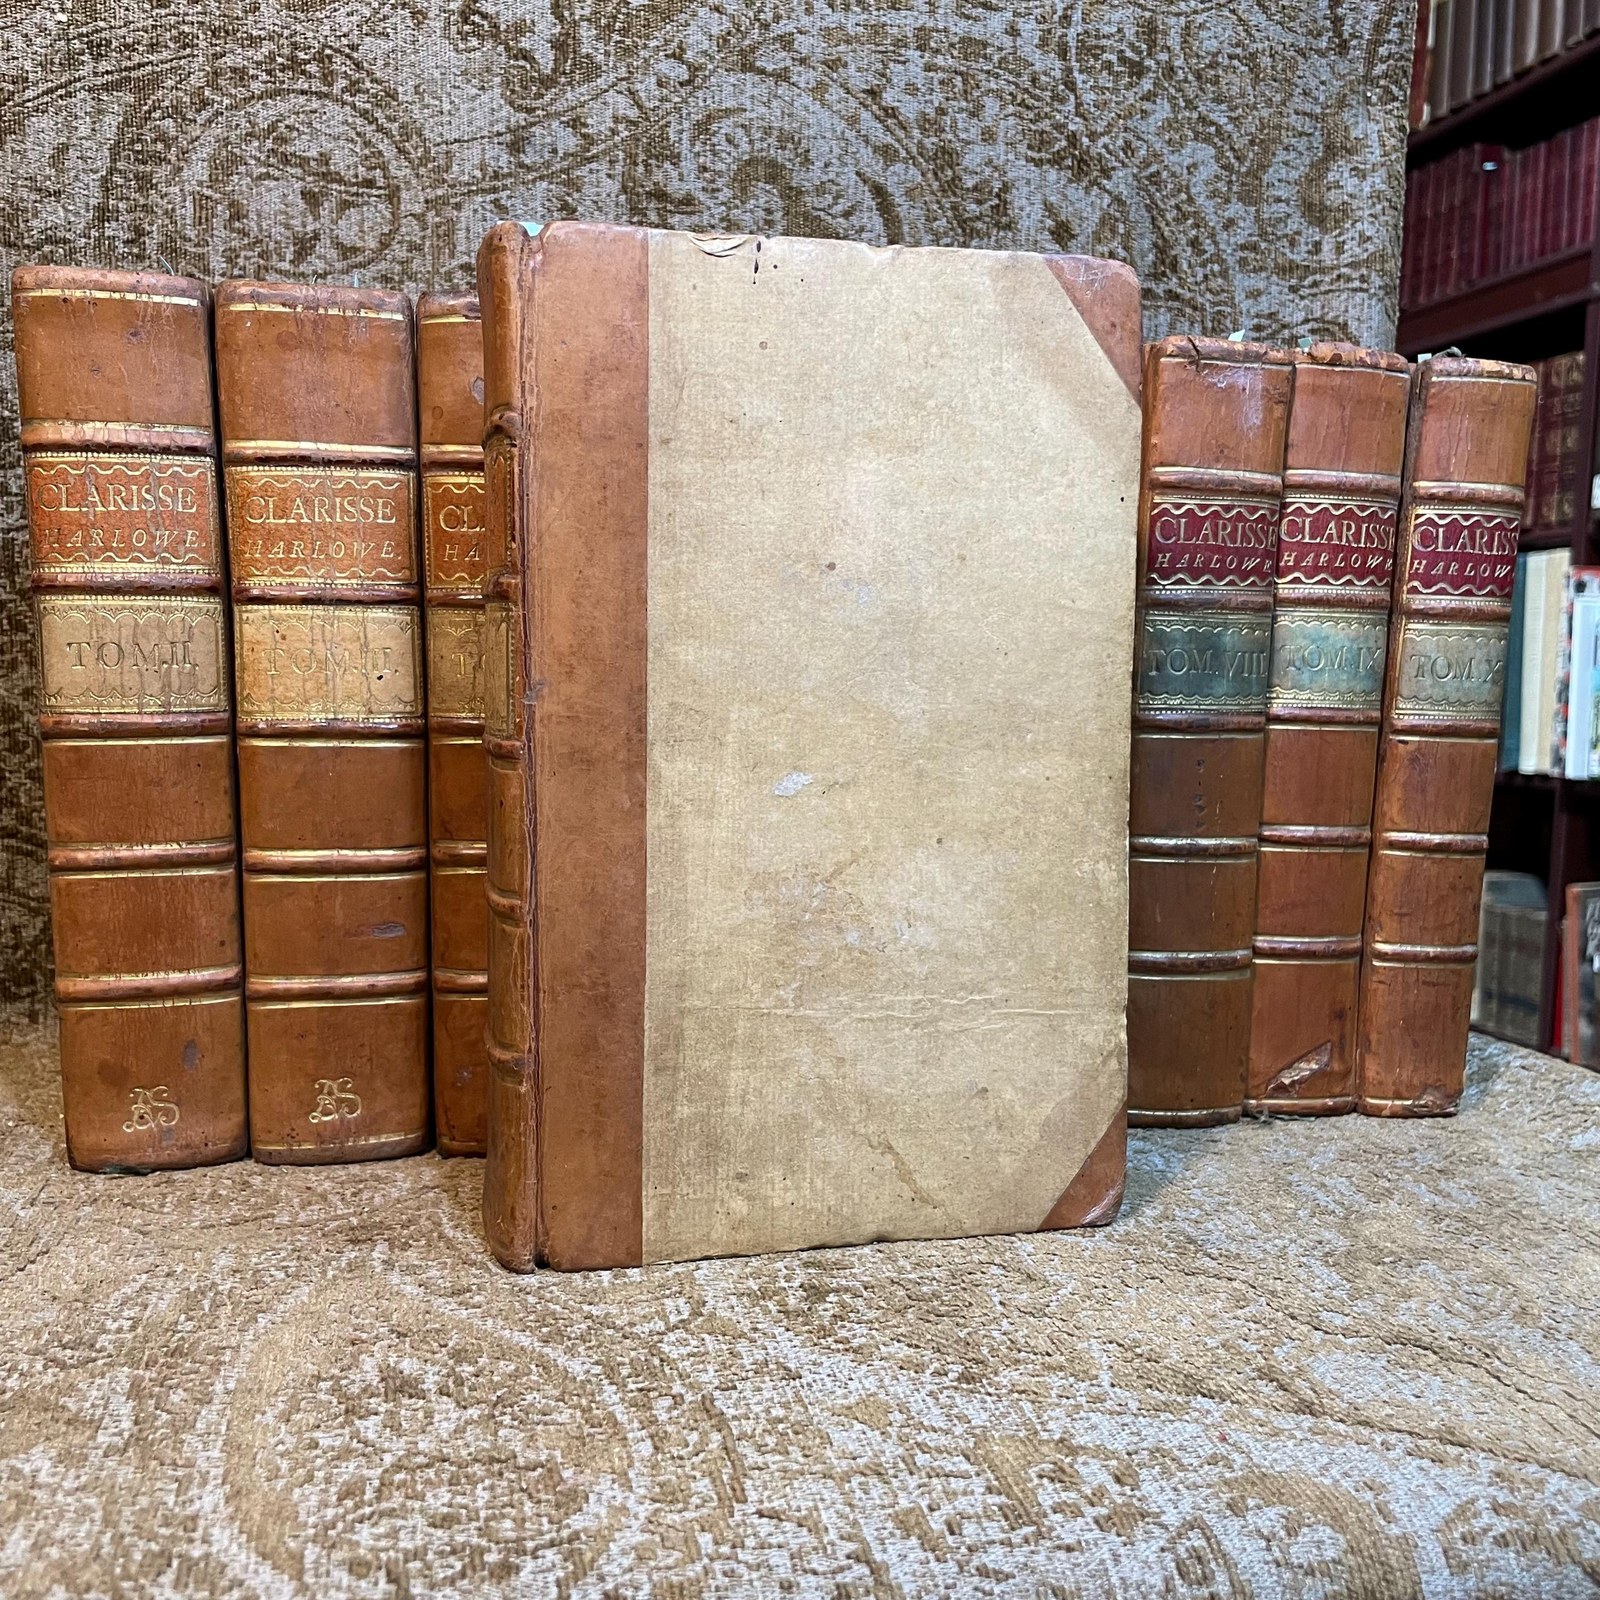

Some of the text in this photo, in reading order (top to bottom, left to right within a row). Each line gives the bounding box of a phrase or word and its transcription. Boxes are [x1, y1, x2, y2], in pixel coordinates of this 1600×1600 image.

[35, 482, 199, 513] CLARISSE
[244, 496, 397, 524] CLARISSE
[1154, 516, 1278, 551] CLARISSE
[1411, 525, 1519, 556] CLARISS
[1154, 552, 1272, 573] HARLOWE
[1409, 559, 1516, 578] HARLOW
